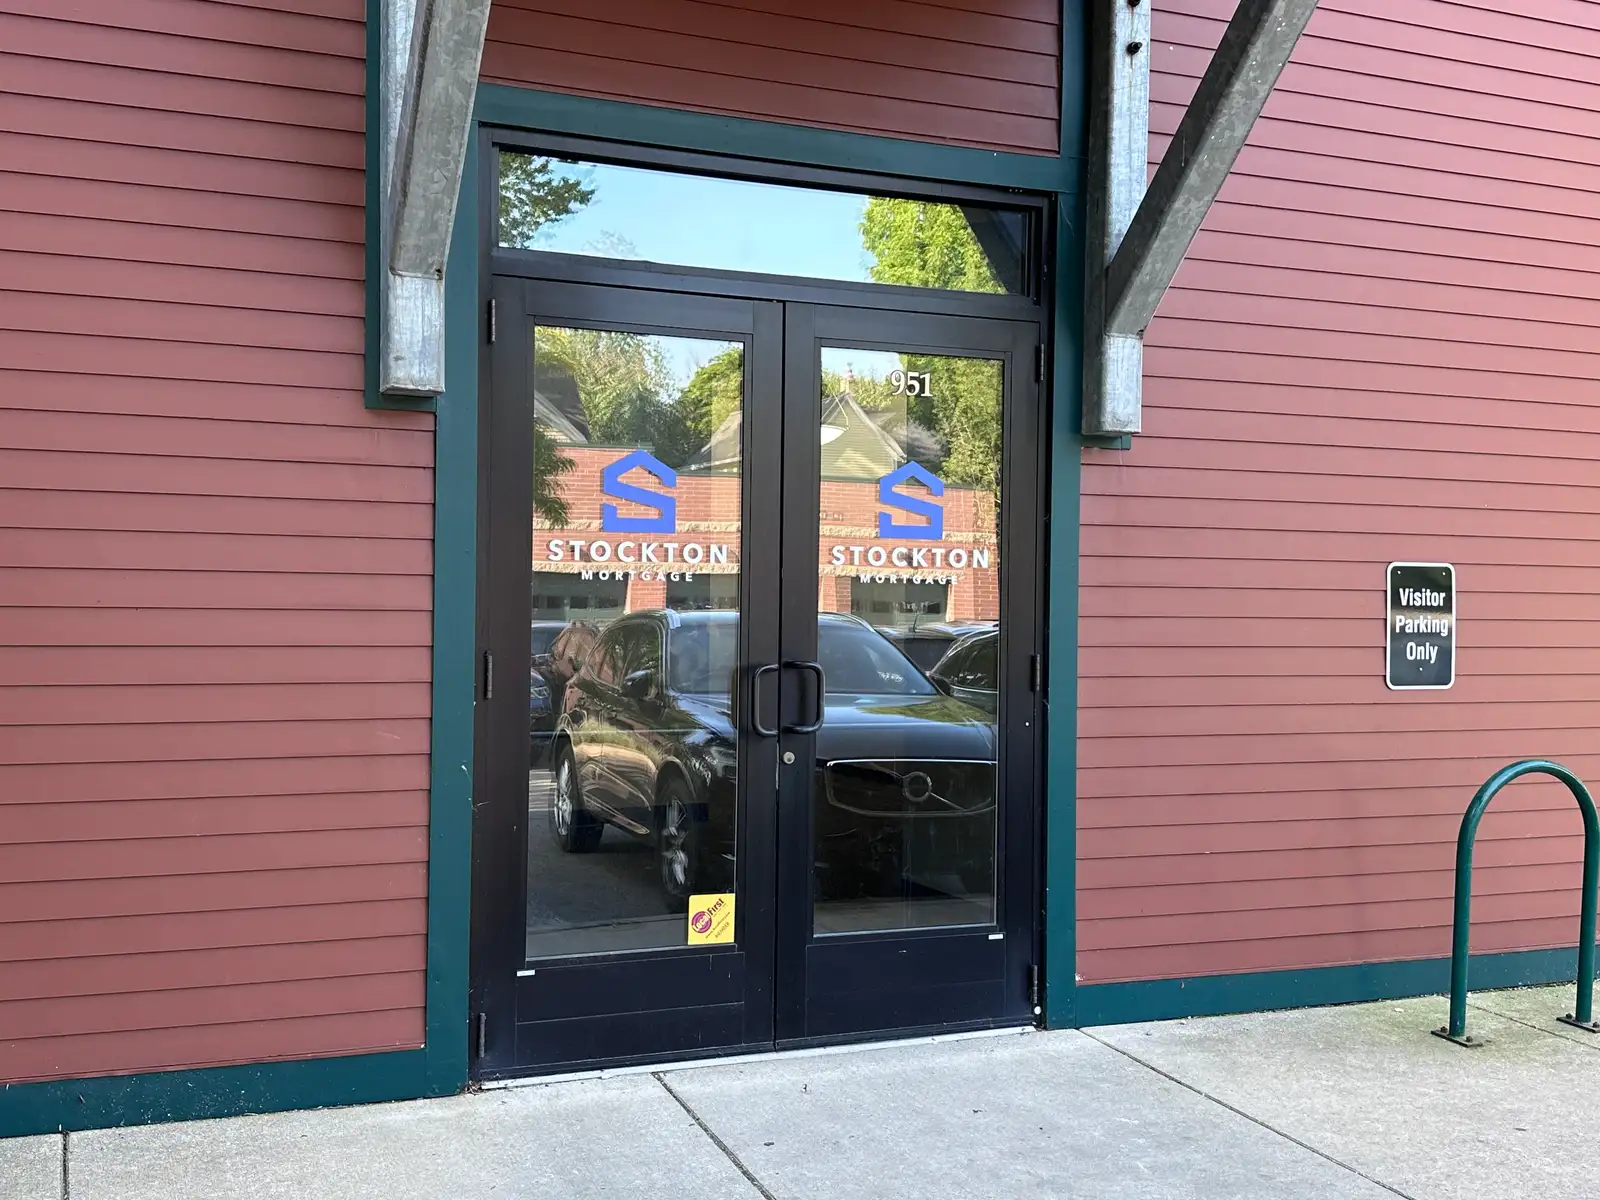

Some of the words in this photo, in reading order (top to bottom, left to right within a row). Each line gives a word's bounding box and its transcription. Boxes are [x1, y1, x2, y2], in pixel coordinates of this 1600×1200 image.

[891, 370, 933, 397] 951
[549, 539, 728, 564] STOCKTON
[831, 545, 990, 569] STOCKTON
[581, 570, 693, 582] MORTGAGE
[860, 574, 959, 585] MORTGAGE
[1399, 588, 1446, 607] Visitor
[1395, 615, 1449, 637] Parking
[1406, 641, 1438, 664] Only
[706, 898, 724, 916] First
